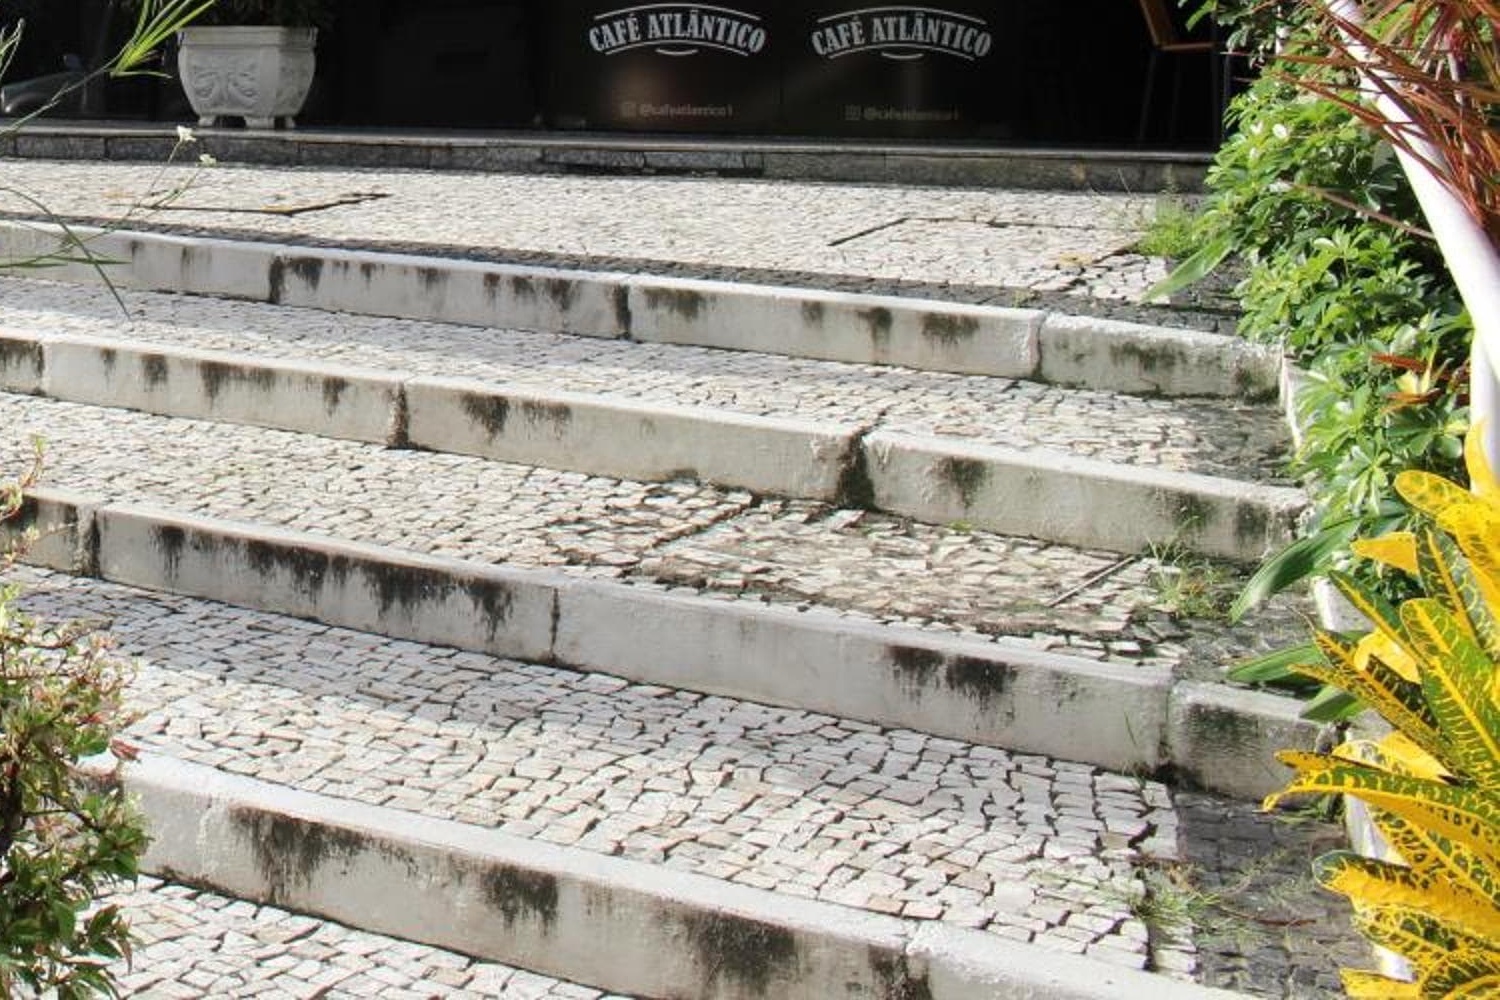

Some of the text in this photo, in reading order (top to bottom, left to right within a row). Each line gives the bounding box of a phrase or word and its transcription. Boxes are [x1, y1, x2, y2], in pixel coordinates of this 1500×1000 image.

[588, 9, 767, 53] CAFÉ ATLÂNTICO
[811, 13, 992, 57] CAFÉ ATLÂNTICO
